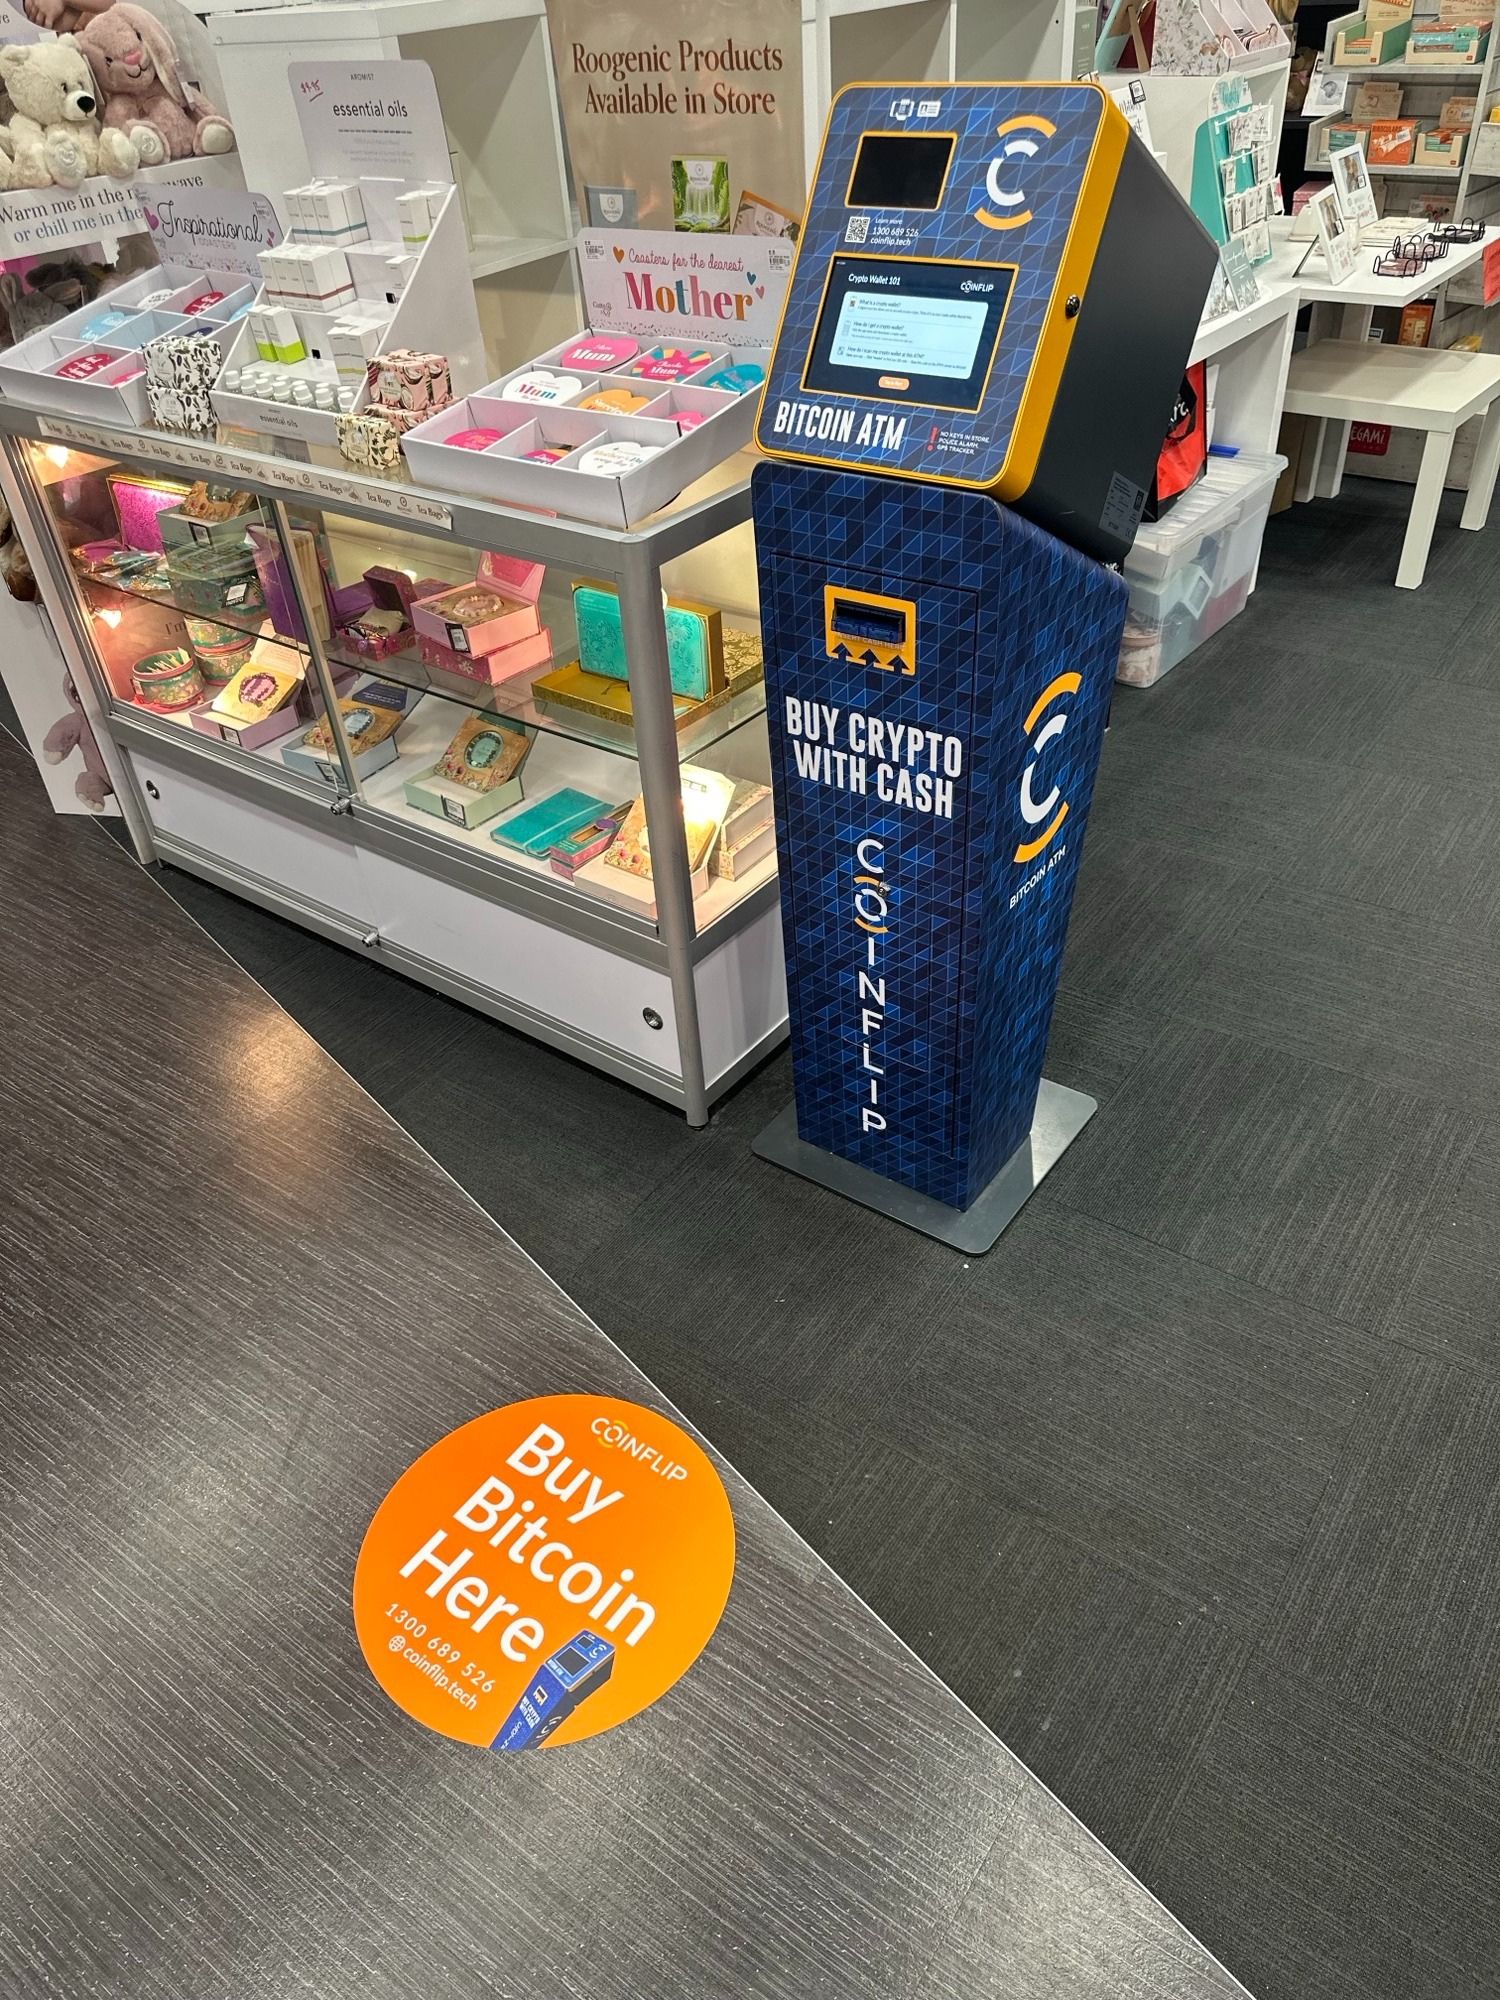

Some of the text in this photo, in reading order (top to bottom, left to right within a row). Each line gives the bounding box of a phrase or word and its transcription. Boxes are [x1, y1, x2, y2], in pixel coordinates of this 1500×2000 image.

[572, 38, 784, 81] Roogenic Products
[333, 99, 408, 117] essential oils
[585, 82, 776, 114] Available in Store
[0, 202, 49, 224] Warm
[51, 197, 77, 213] me
[77, 191, 96, 210] in
[97, 187, 122, 206] the
[13, 203, 143, 244] or chill me in the
[157, 200, 263, 247] Inspirational
[870, 236, 911, 247] coinflip.tech
[872, 226, 919, 238] 1300 689 526
[628, 247, 744, 272] Coasters for the dearest
[848, 273, 901, 287] Crypto Wallet 101
[622, 271, 753, 321] Mother
[960, 280, 994, 293] COINFLIP
[570, 349, 616, 362] Mum
[515, 384, 558, 400] Mum
[773, 400, 907, 451] BITCOIN ATM
[272, 470, 282, 480] Tea
[282, 472, 295, 485] Bags
[318, 480, 328, 490] Tea
[328, 482, 343, 495] Bags
[366, 491, 377, 501] Tea
[376, 494, 392, 507] Bags
[416, 504, 427, 515] Tea
[427, 507, 444, 520] Bags
[785, 695, 962, 778] BUY CRYPTO
[793, 739, 954, 820] WITH CASH
[1009, 845, 1067, 910] BITCOIN ATM
[853, 838, 890, 1132] COINFLIP
[505, 1423, 625, 1524] Buy
[591, 1417, 689, 1482] COINFLIP
[453, 1475, 656, 1648] Bitcoin
[399, 1529, 545, 1663] Here
[385, 1602, 496, 1694] 1300 689 526
[402, 1647, 479, 1711] coinflip.tech
